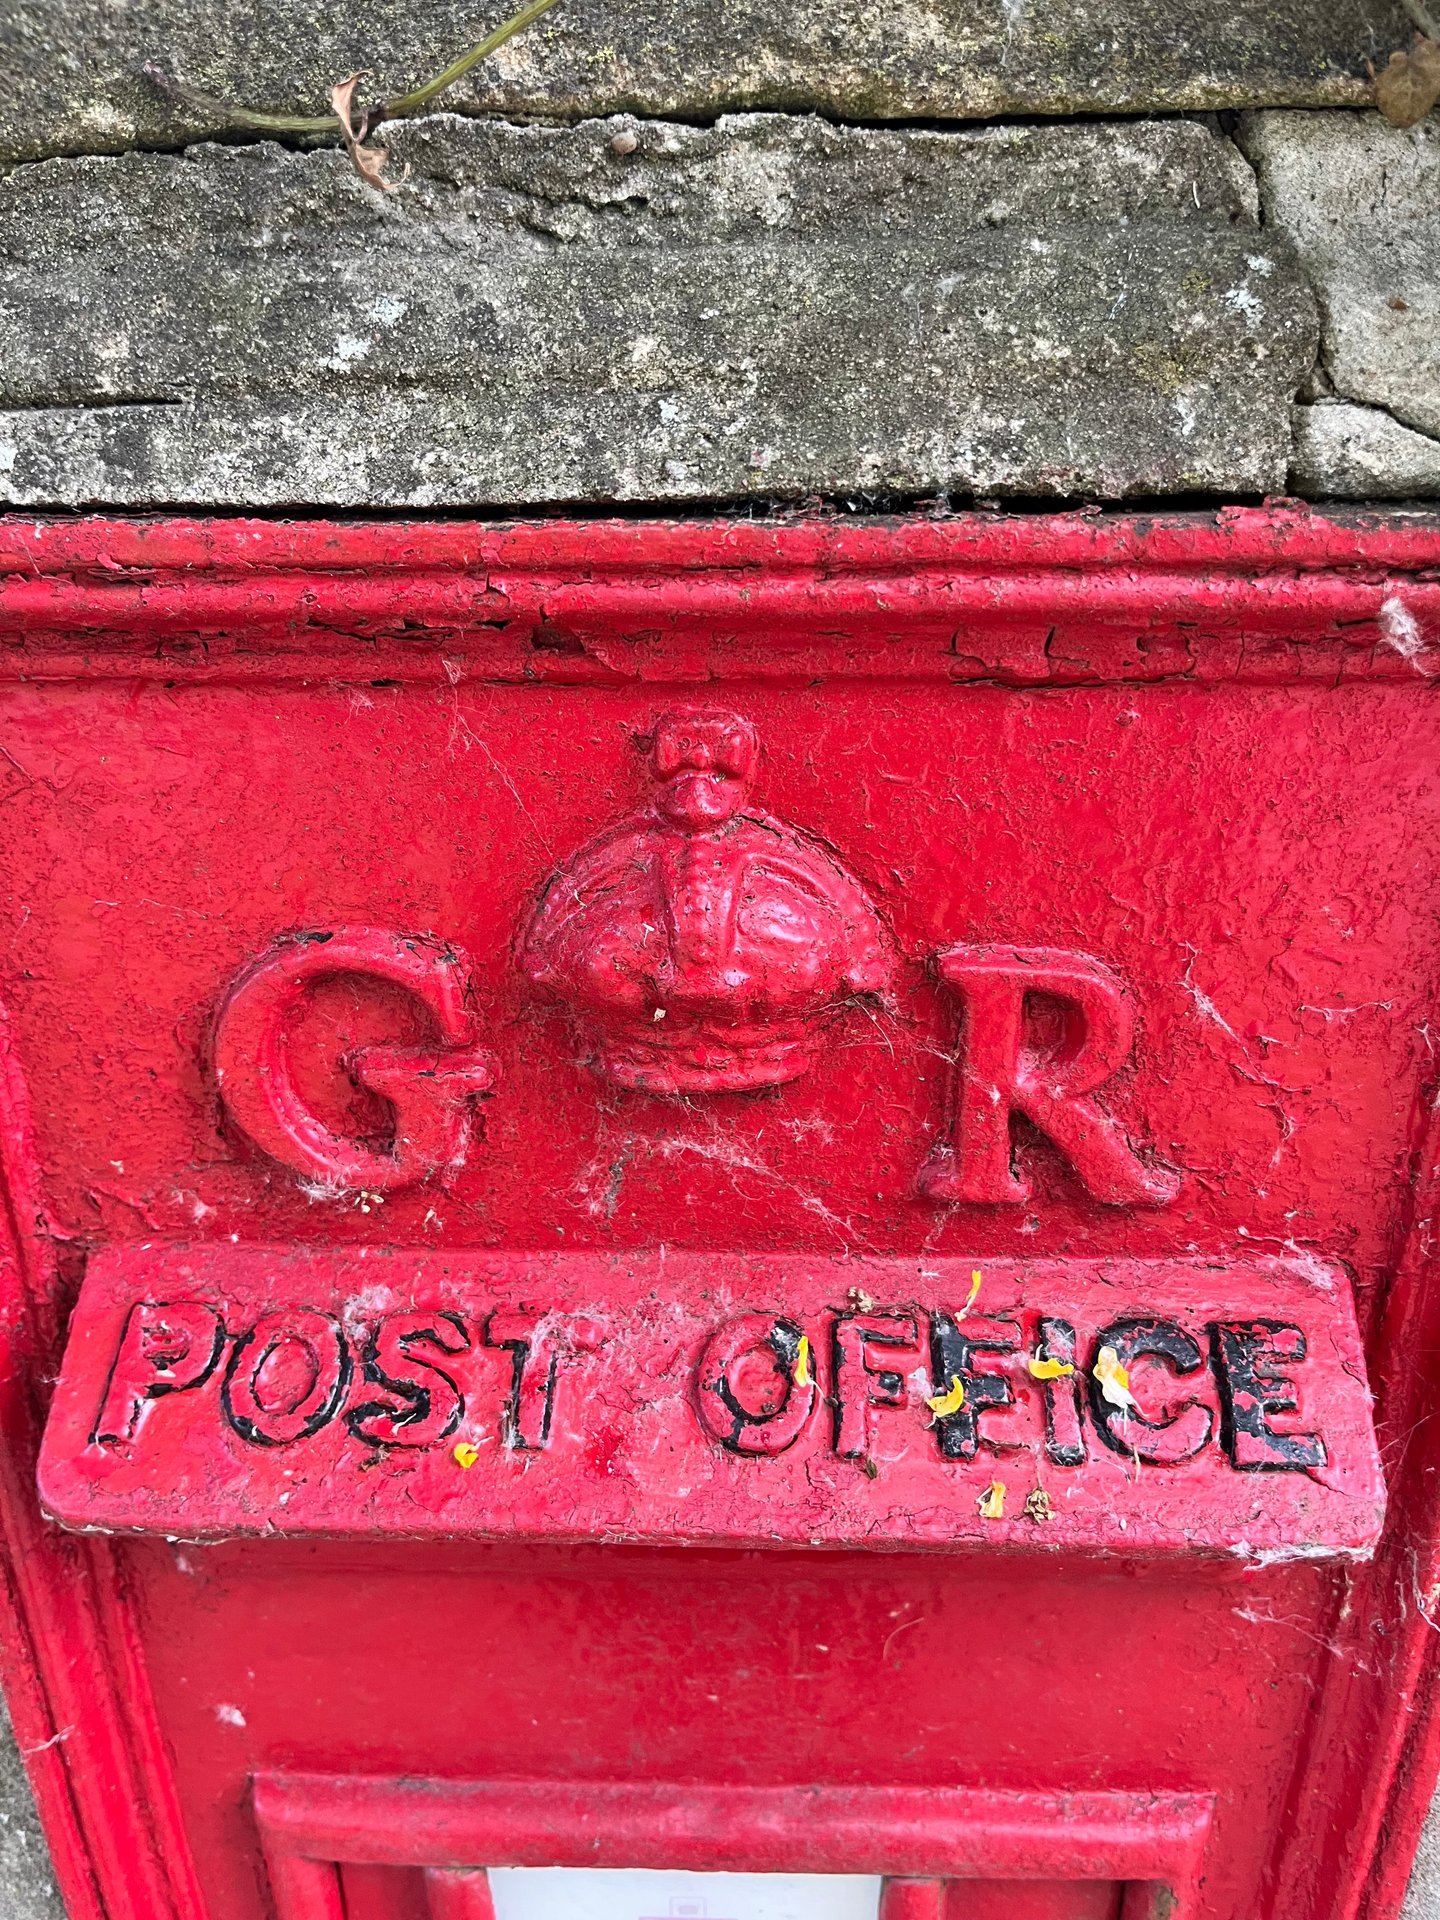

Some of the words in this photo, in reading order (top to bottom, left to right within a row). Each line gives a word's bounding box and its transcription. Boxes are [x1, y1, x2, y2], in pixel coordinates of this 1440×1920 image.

[212, 925, 492, 1193] G
[918, 943, 1181, 1204] R
[89, 1300, 602, 1451] POST
[696, 1306, 1327, 1471] OFFICE
